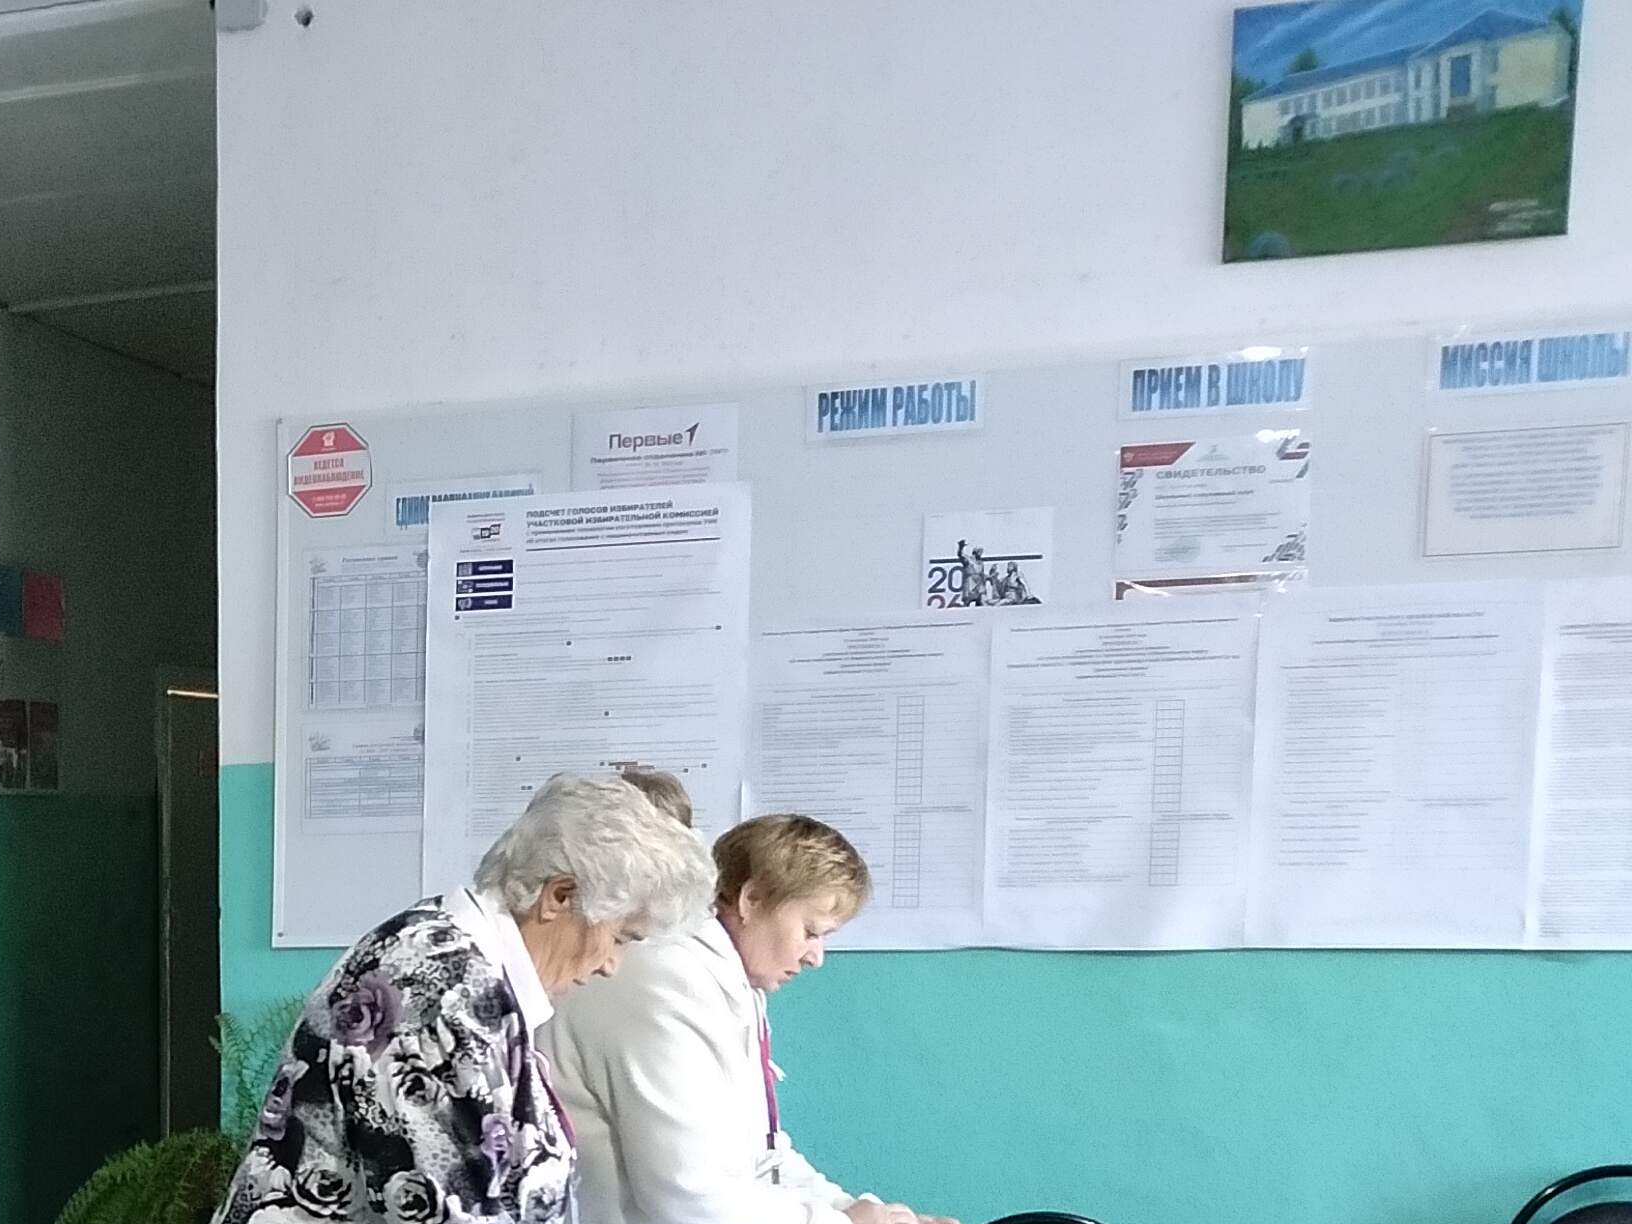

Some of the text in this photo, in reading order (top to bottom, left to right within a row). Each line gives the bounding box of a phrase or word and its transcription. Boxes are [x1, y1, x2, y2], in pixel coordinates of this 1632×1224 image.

[1439, 339, 1533, 390] МИССИЯ
[1131, 358, 1306, 412] ПРИЕМ В ШКОЛУ
[817, 380, 977, 433] РЕЖИМ РАБОТЫ
[608, 432, 683, 452] Первые
[1155, 465, 1266, 480] СВИДЕТЕЛЬСТВО
[526, 508, 566, 518] ПОДСЧЕТ
[567, 506, 608, 516] ГОЛОСОВ
[928, 565, 964, 594] 20
